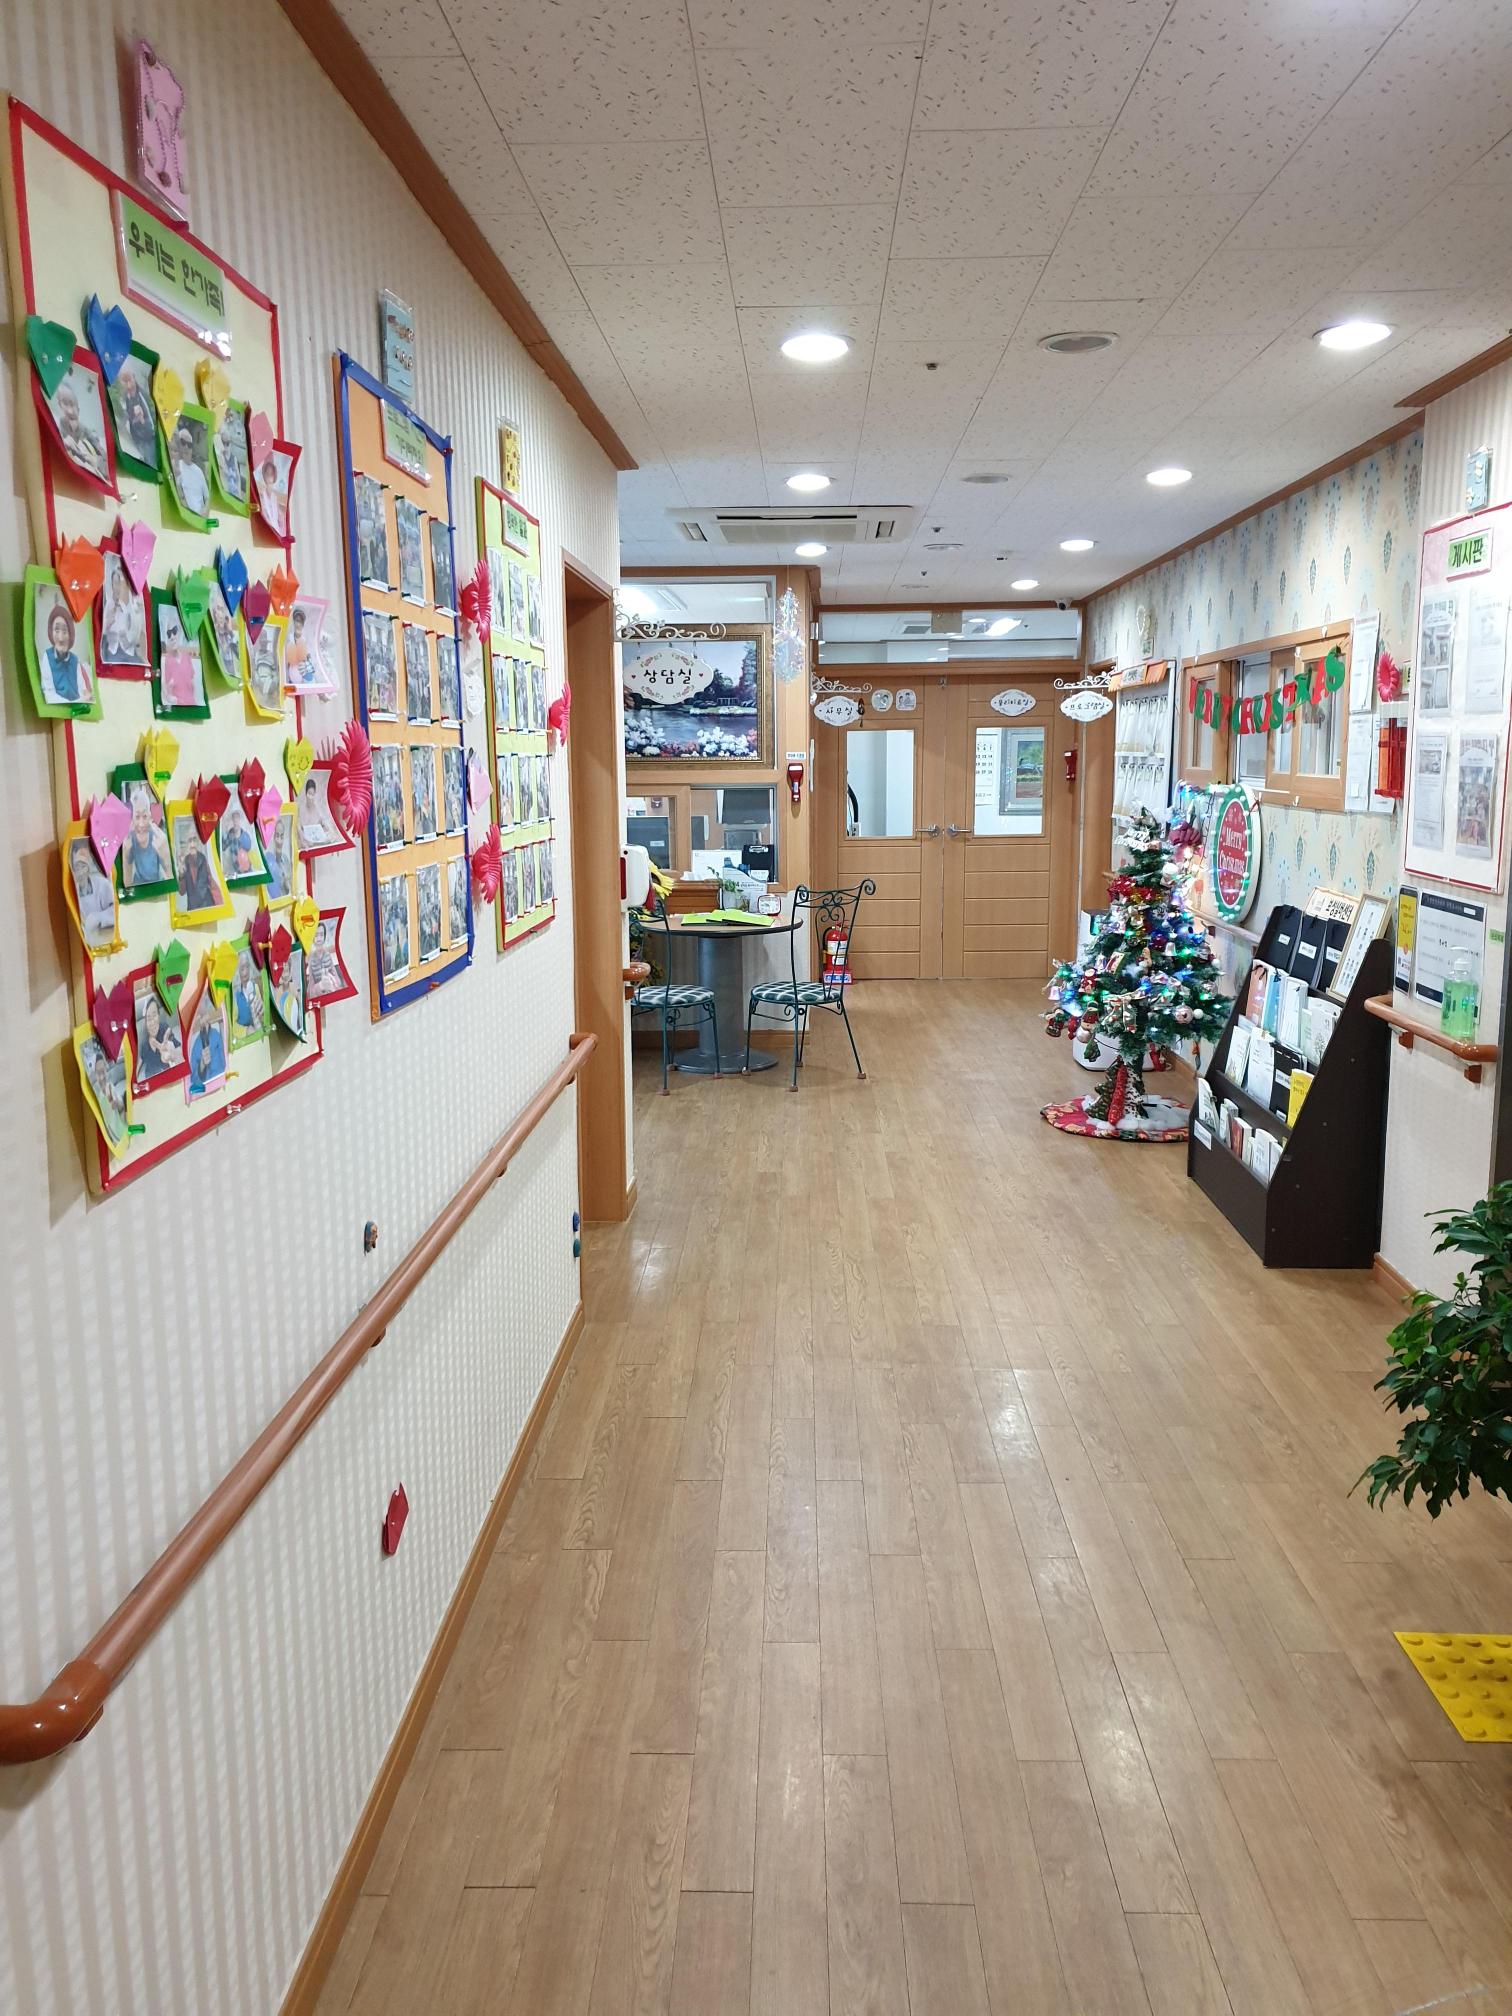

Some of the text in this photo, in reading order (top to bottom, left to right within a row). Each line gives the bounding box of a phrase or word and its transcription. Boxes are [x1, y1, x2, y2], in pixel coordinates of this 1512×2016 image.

[128, 221, 225, 317] 우리는 한가족
[1452, 537, 1484, 568] 게시판
[643, 668, 692, 685] 상담실
[825, 706, 853, 716] 사무실
[1069, 701, 1105, 711] 프로그램실
[1225, 827, 1243, 850] Merry
